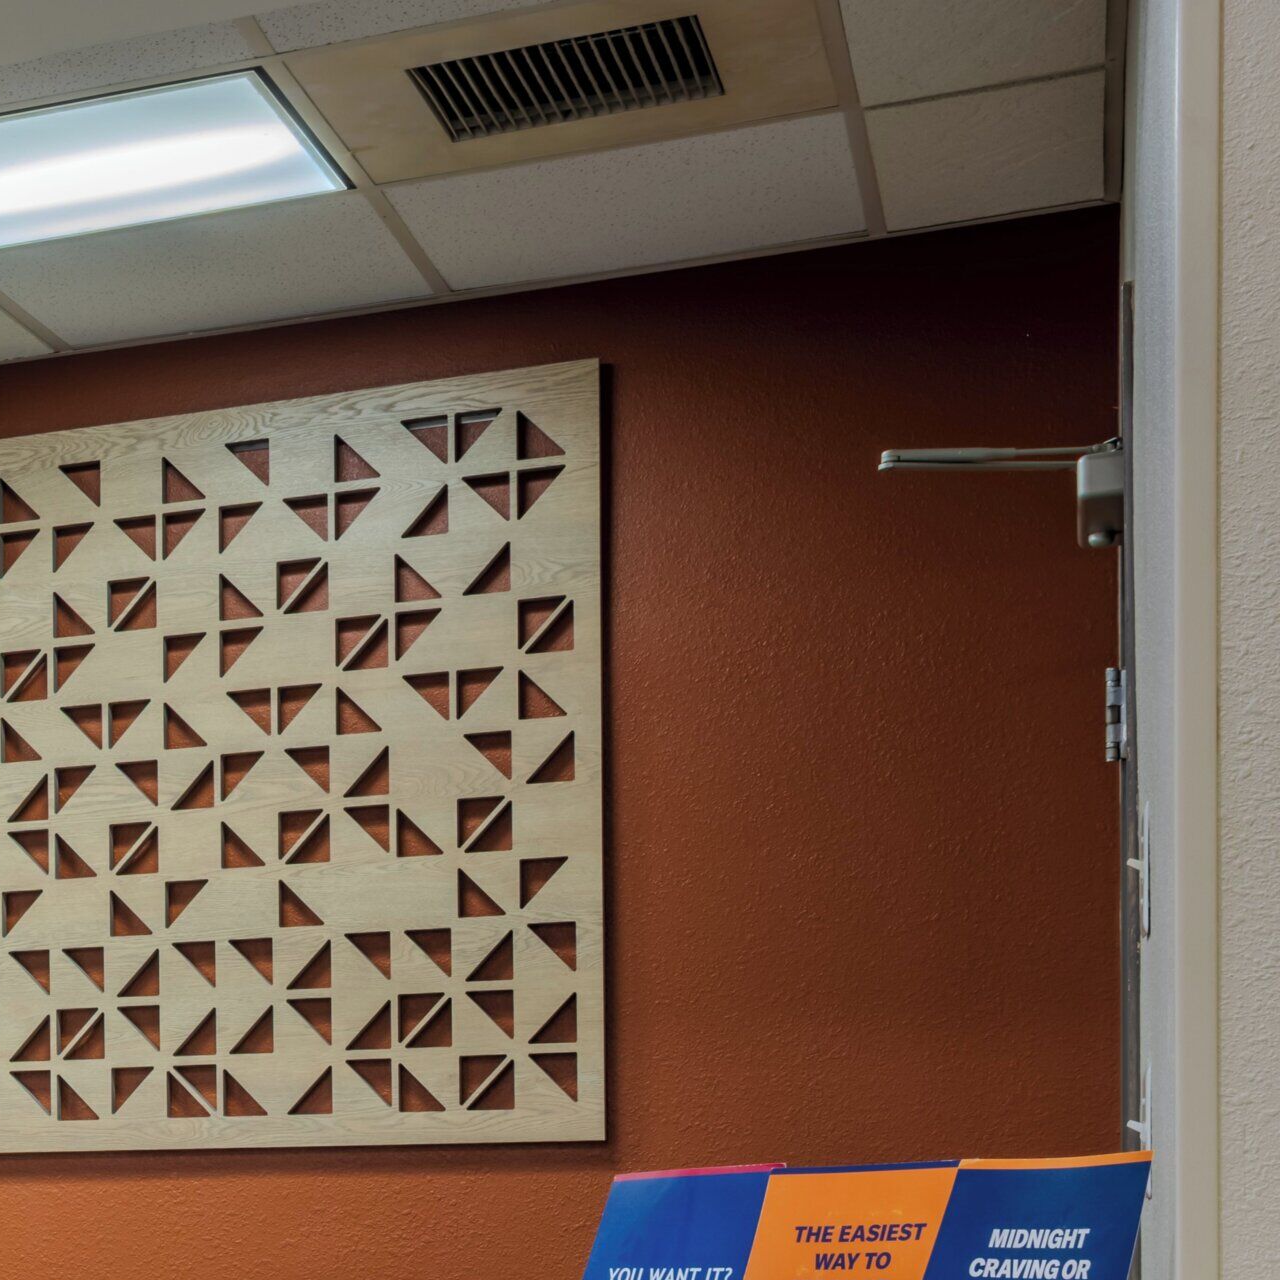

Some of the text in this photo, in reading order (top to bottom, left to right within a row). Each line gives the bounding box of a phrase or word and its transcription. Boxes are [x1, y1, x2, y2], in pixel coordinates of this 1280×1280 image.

[795, 1223, 927, 1243] THE EASIEST
[988, 1228, 1090, 1249] MIDNIGHT
[815, 1252, 892, 1270] WAY TO
[968, 1257, 1091, 1280] CRAVING OR
